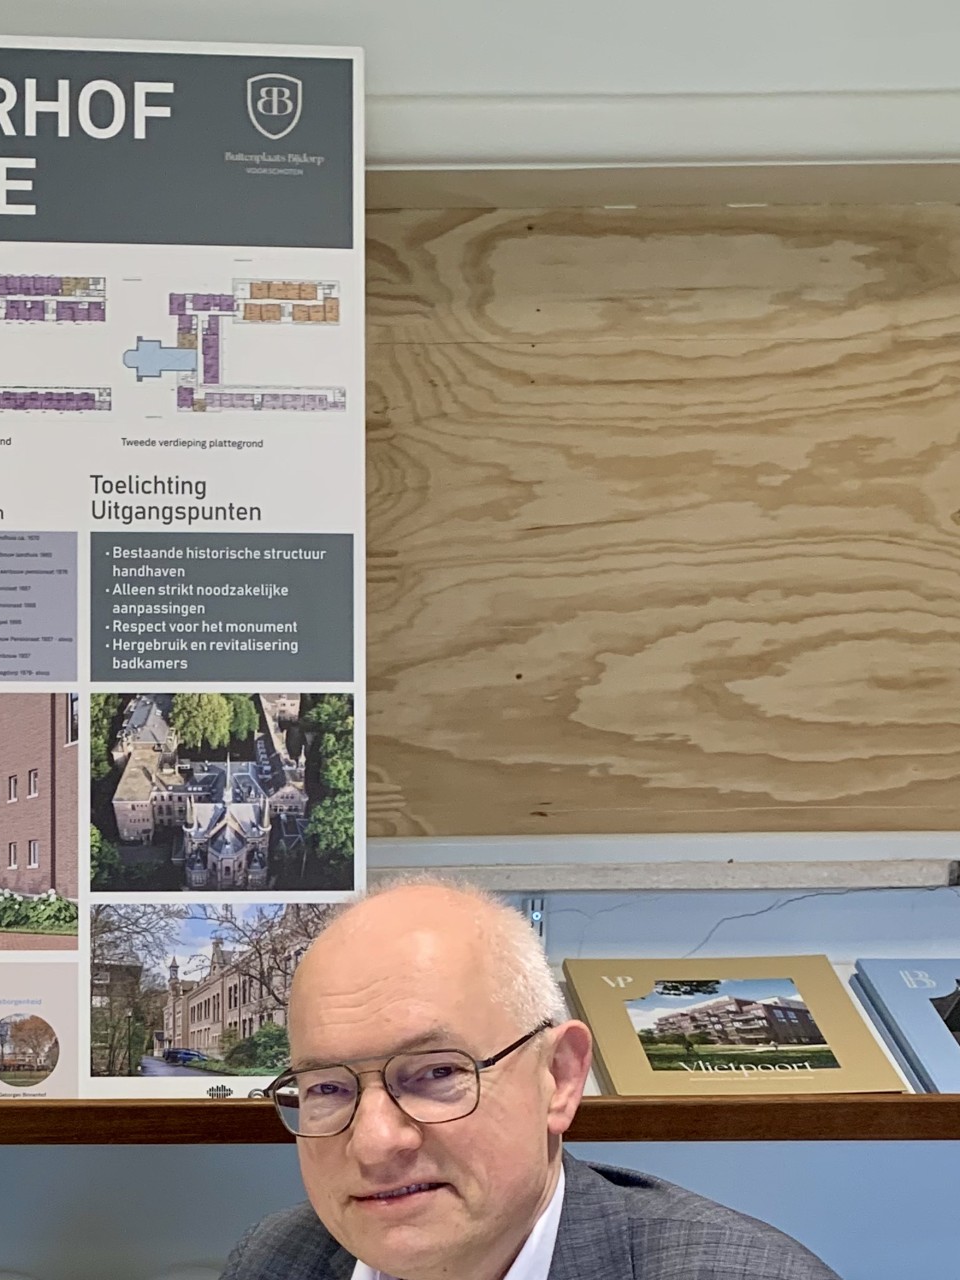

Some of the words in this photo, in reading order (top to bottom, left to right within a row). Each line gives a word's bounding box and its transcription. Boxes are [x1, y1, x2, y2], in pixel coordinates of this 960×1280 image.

[121, 438, 157, 448] Tweede
[158, 438, 207, 450] verdieping
[209, 439, 264, 450] plattegrond
[90, 474, 207, 500] Toelichting
[91, 500, 262, 525] Uitgangspunten
[112, 546, 184, 560] Bestaande
[186, 547, 261, 560] historische
[264, 548, 327, 560] structuur
[112, 565, 186, 578] handhaven
[112, 583, 156, 596] Alleen
[158, 583, 194, 596] strikt
[196, 584, 289, 599] noodzakelijke
[112, 602, 206, 618] aanpassingen
[112, 620, 166, 636] Respect
[168, 623, 200, 634] voor
[202, 620, 223, 634] het
[226, 622, 298, 634] monument
[112, 638, 188, 654] Hergebruik
[190, 641, 207, 651] en
[210, 638, 299, 654] revitalisering
[112, 656, 188, 670] badkamers
[678, 1060, 815, 1078] Vlietpoort
